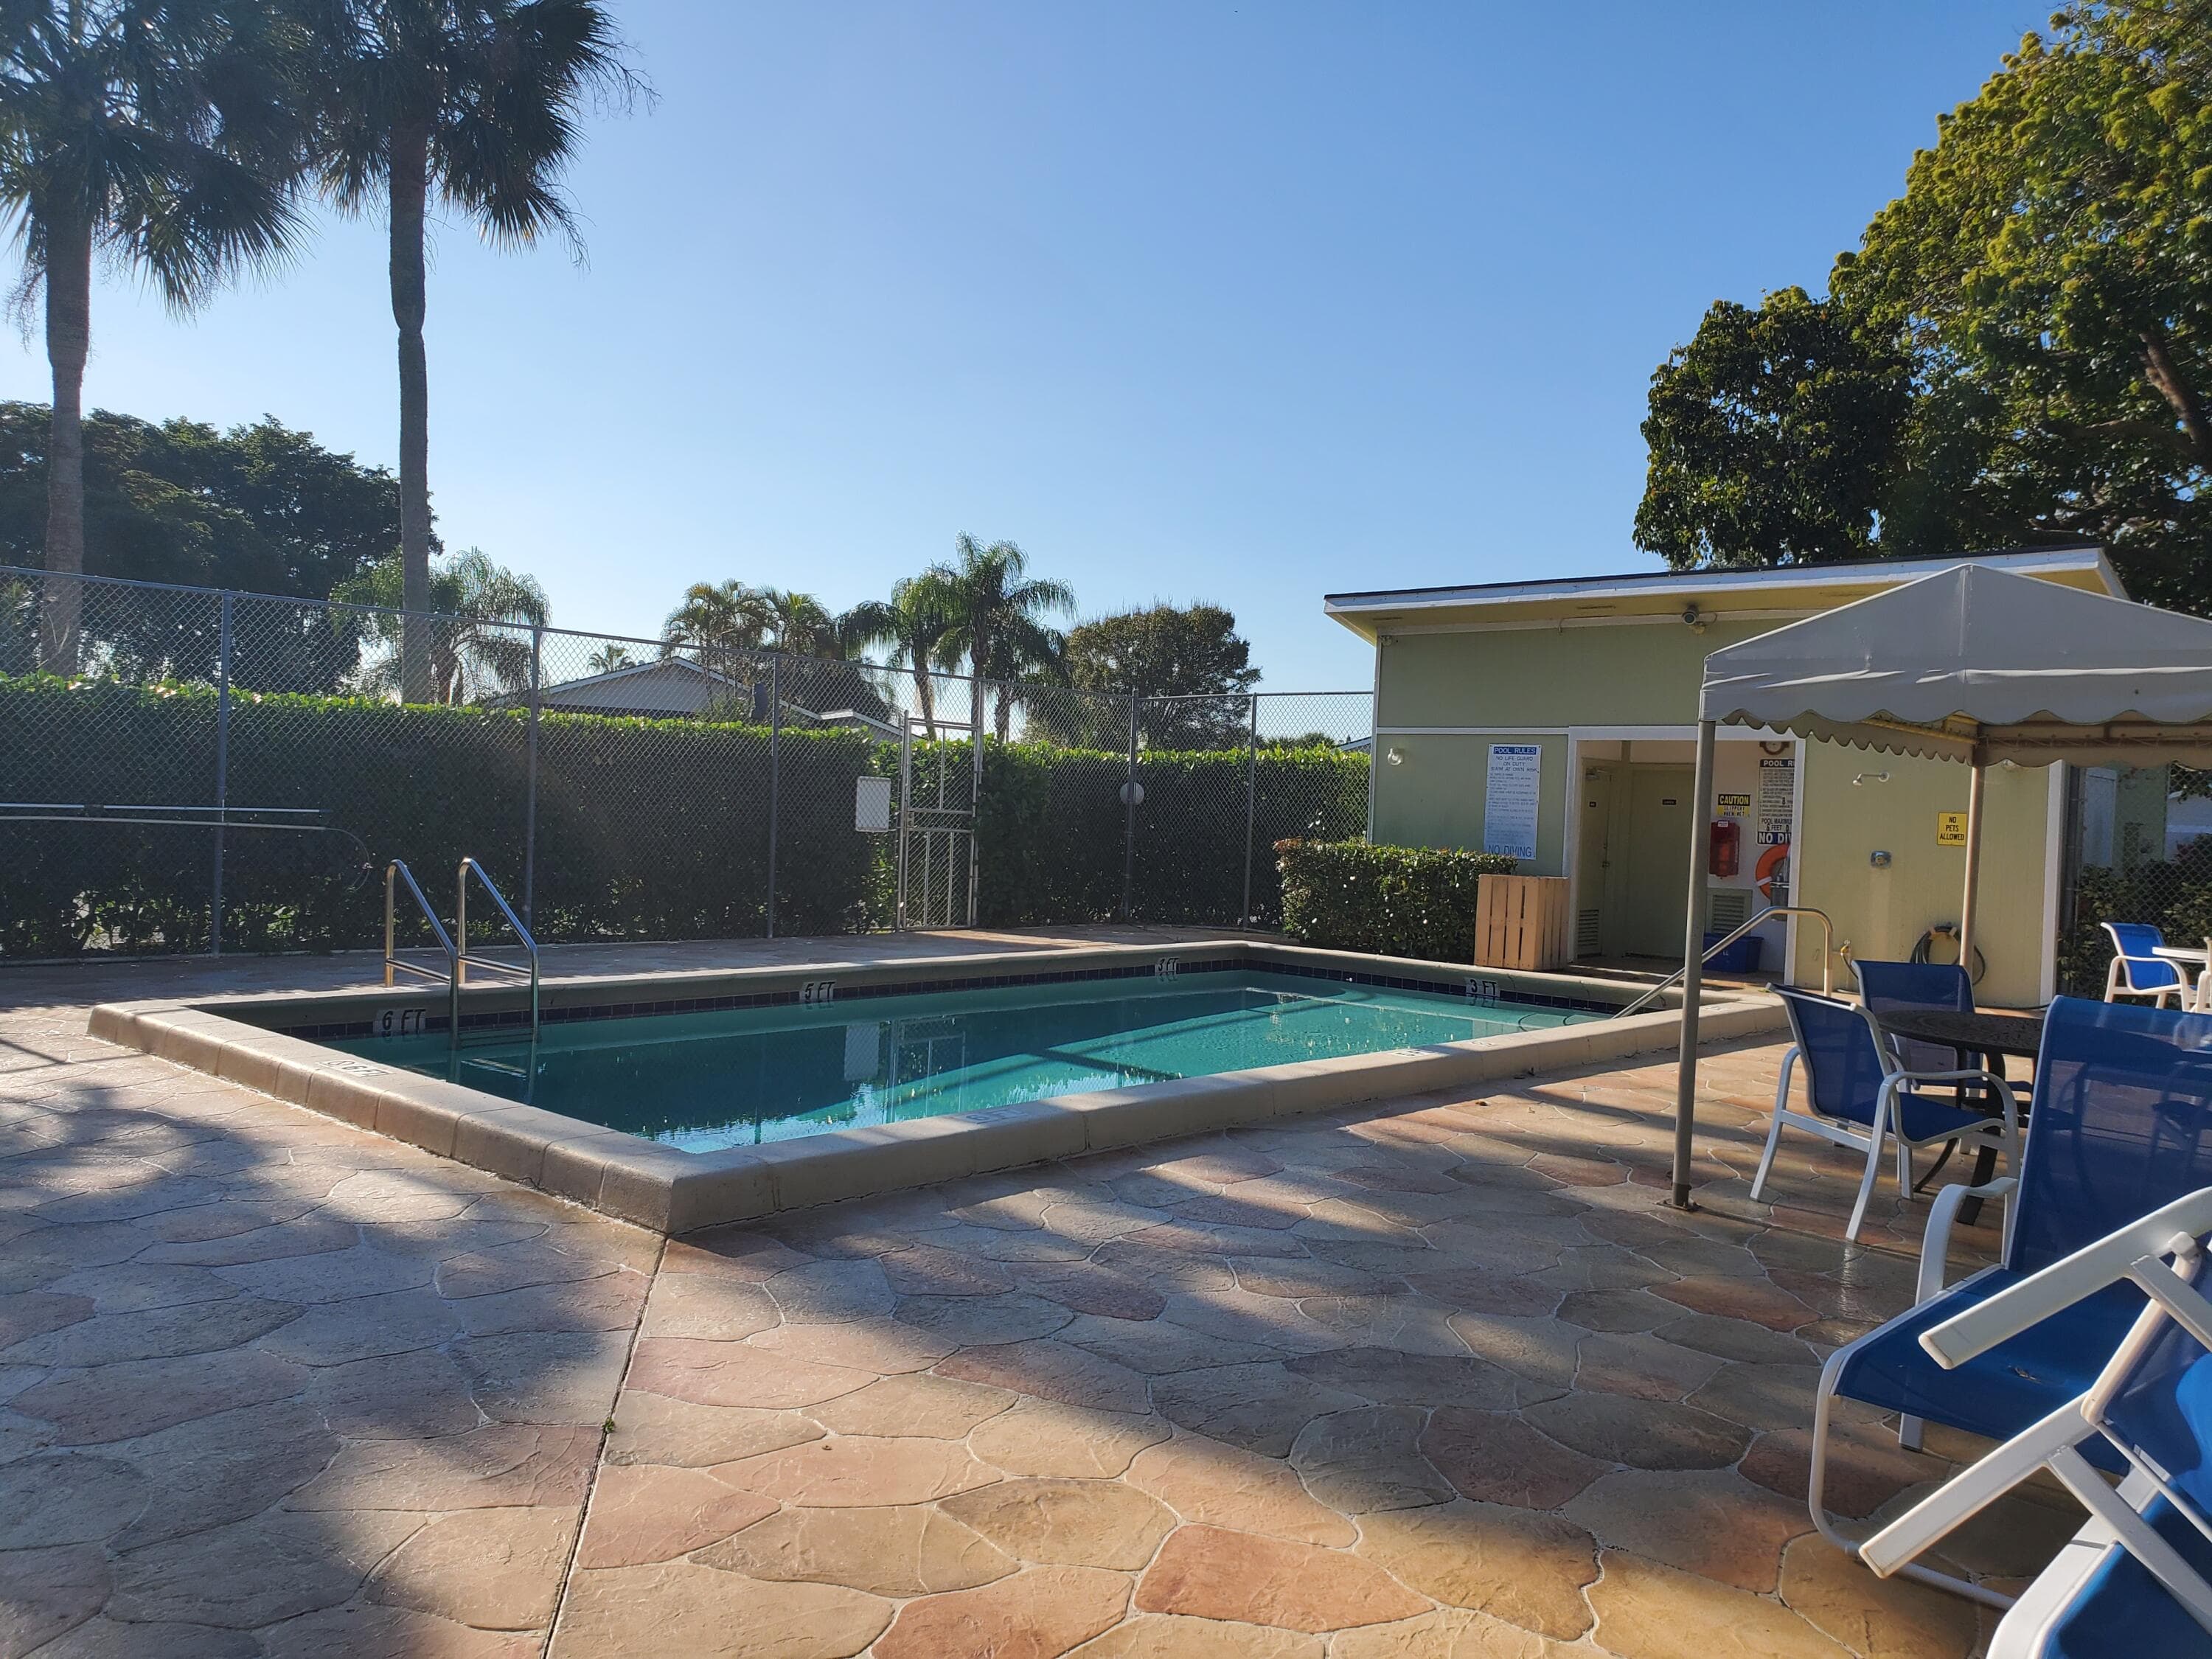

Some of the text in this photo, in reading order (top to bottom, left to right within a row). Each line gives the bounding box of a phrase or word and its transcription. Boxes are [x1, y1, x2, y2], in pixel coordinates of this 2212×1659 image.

[1719, 796, 1749, 804] CAUTION
[1759, 832, 1773, 844] NO
[1488, 844, 1532, 858] NO DIVING
[1158, 957, 1180, 972] 3 FT
[805, 981, 836, 1001] 5 FT
[1470, 979, 1497, 995] 3 FT
[383, 1009, 426, 1034] 6 FT
